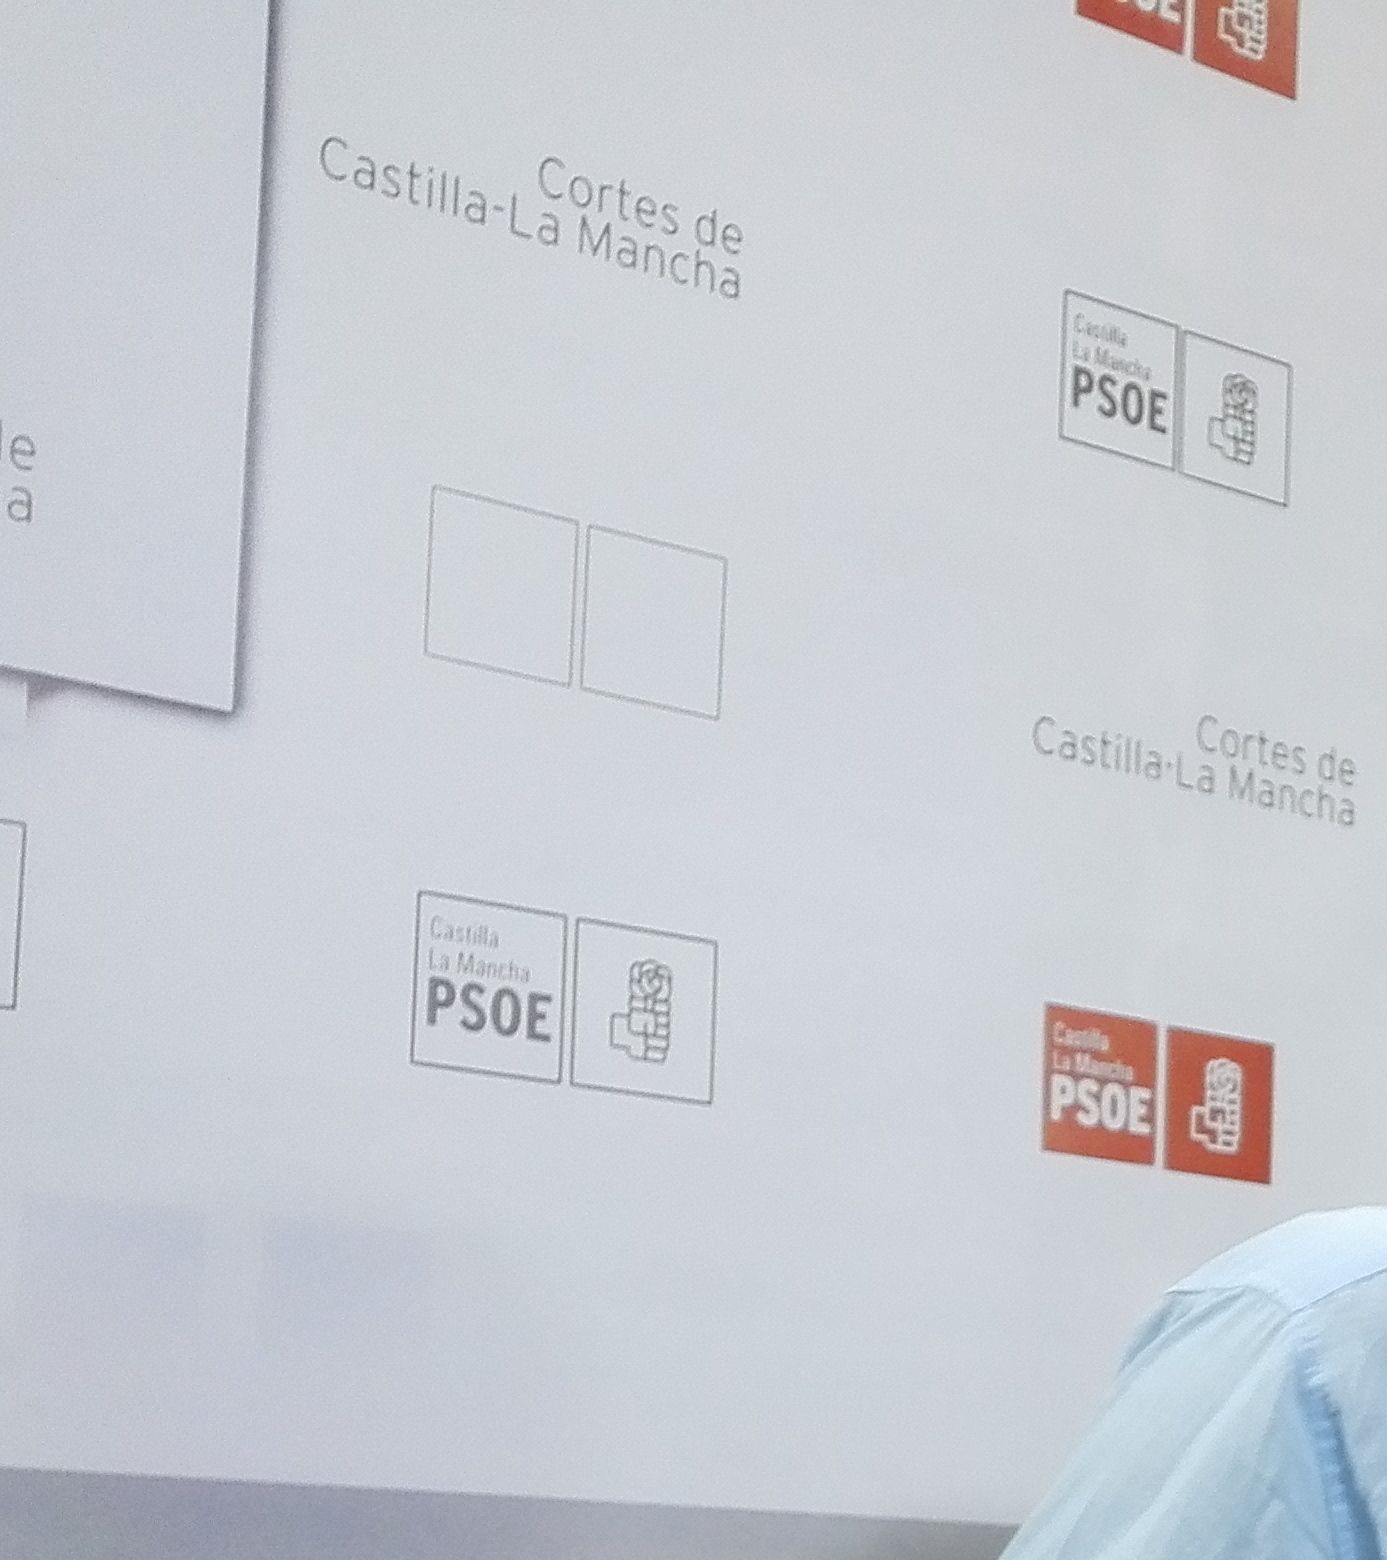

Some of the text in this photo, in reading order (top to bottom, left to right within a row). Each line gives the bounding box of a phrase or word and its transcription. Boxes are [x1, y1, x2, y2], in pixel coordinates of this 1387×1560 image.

[319, 135, 741, 300] Castilla-La Mancha
[537, 155, 745, 255] Cortes de
[1072, 364, 1168, 435] PSOE
[1196, 713, 1356, 787] Cortes de
[1227, 763, 1356, 827] Mancha
[428, 947, 531, 983] La Mancha
[429, 914, 500, 948] Castilla
[426, 975, 553, 1043] PSOE
[1050, 1072, 1153, 1135] PSOE
